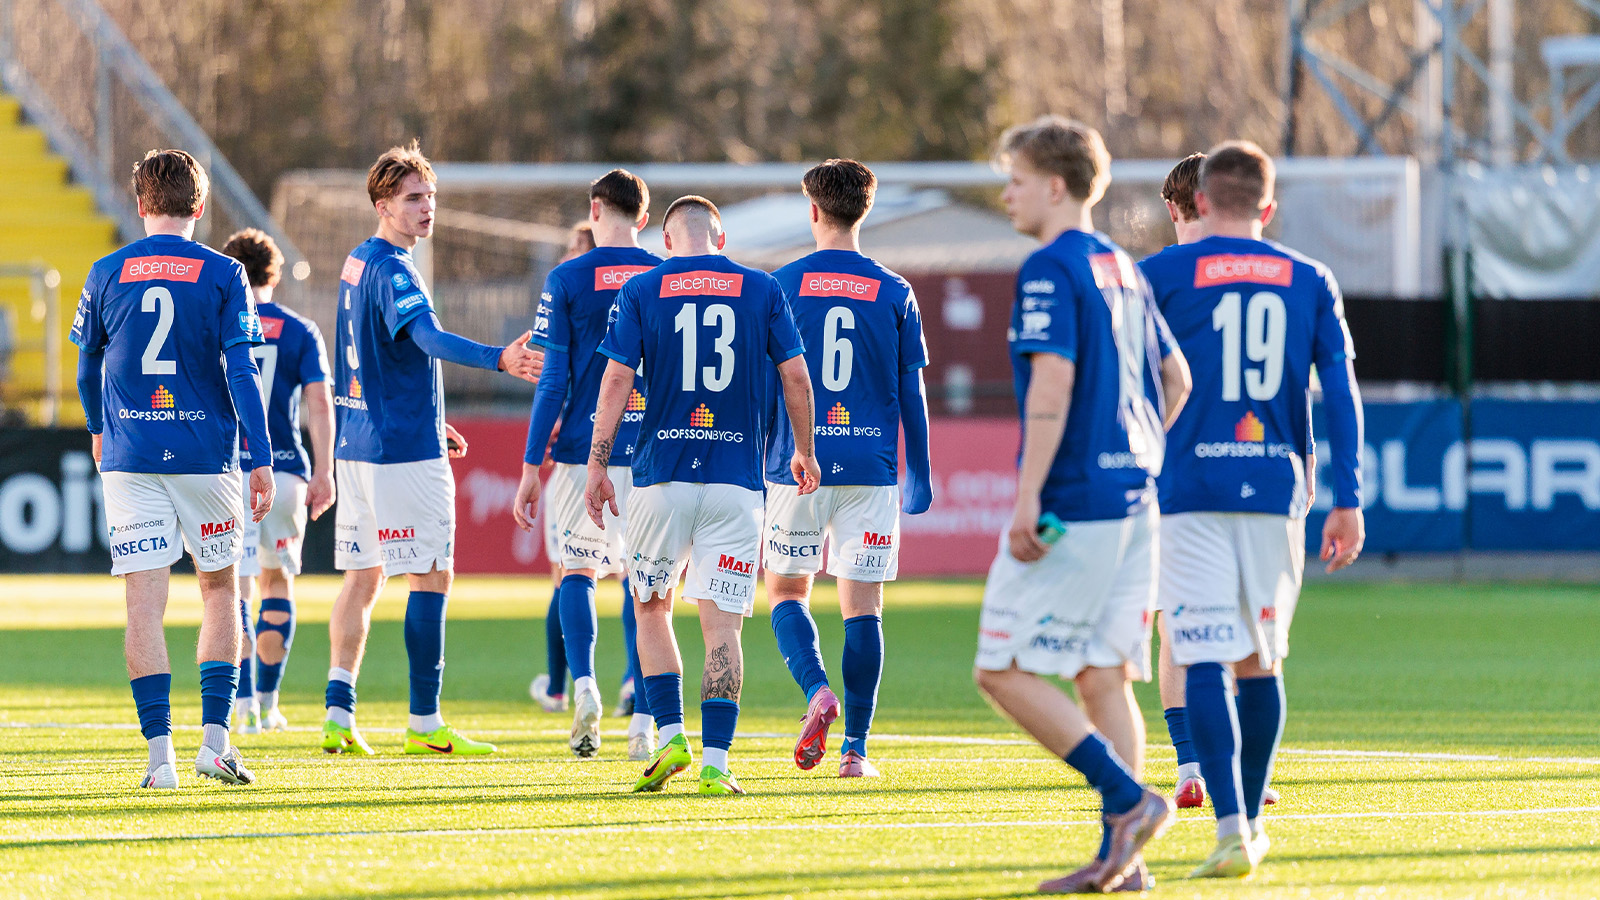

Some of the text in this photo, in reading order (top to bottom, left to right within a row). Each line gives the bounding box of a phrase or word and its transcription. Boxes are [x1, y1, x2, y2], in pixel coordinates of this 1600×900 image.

[129, 261, 194, 276] elcenter
[602, 269, 645, 285] elce
[1205, 257, 1283, 279] elcenter
[669, 276, 734, 291] elcenter
[809, 278, 871, 294] elcenter
[141, 286, 177, 375] 2
[674, 303, 736, 392] 13
[822, 306, 855, 392] 6
[1212, 291, 1287, 402] 19
[119, 409, 206, 421] OLOFSSON BYGG
[657, 428, 713, 440] OLOFSSON
[814, 425, 882, 437] FSSON BYGG
[1194, 441, 1266, 459] OLOFSSON
[116, 519, 165, 533] SCANDICORE
[200, 518, 235, 538] MAXI
[378, 527, 415, 542] MAXI
[111, 536, 168, 558] INSECTA
[769, 539, 822, 558] INSECT
[717, 553, 755, 575] MAXI
[708, 578, 748, 598] ERLA
